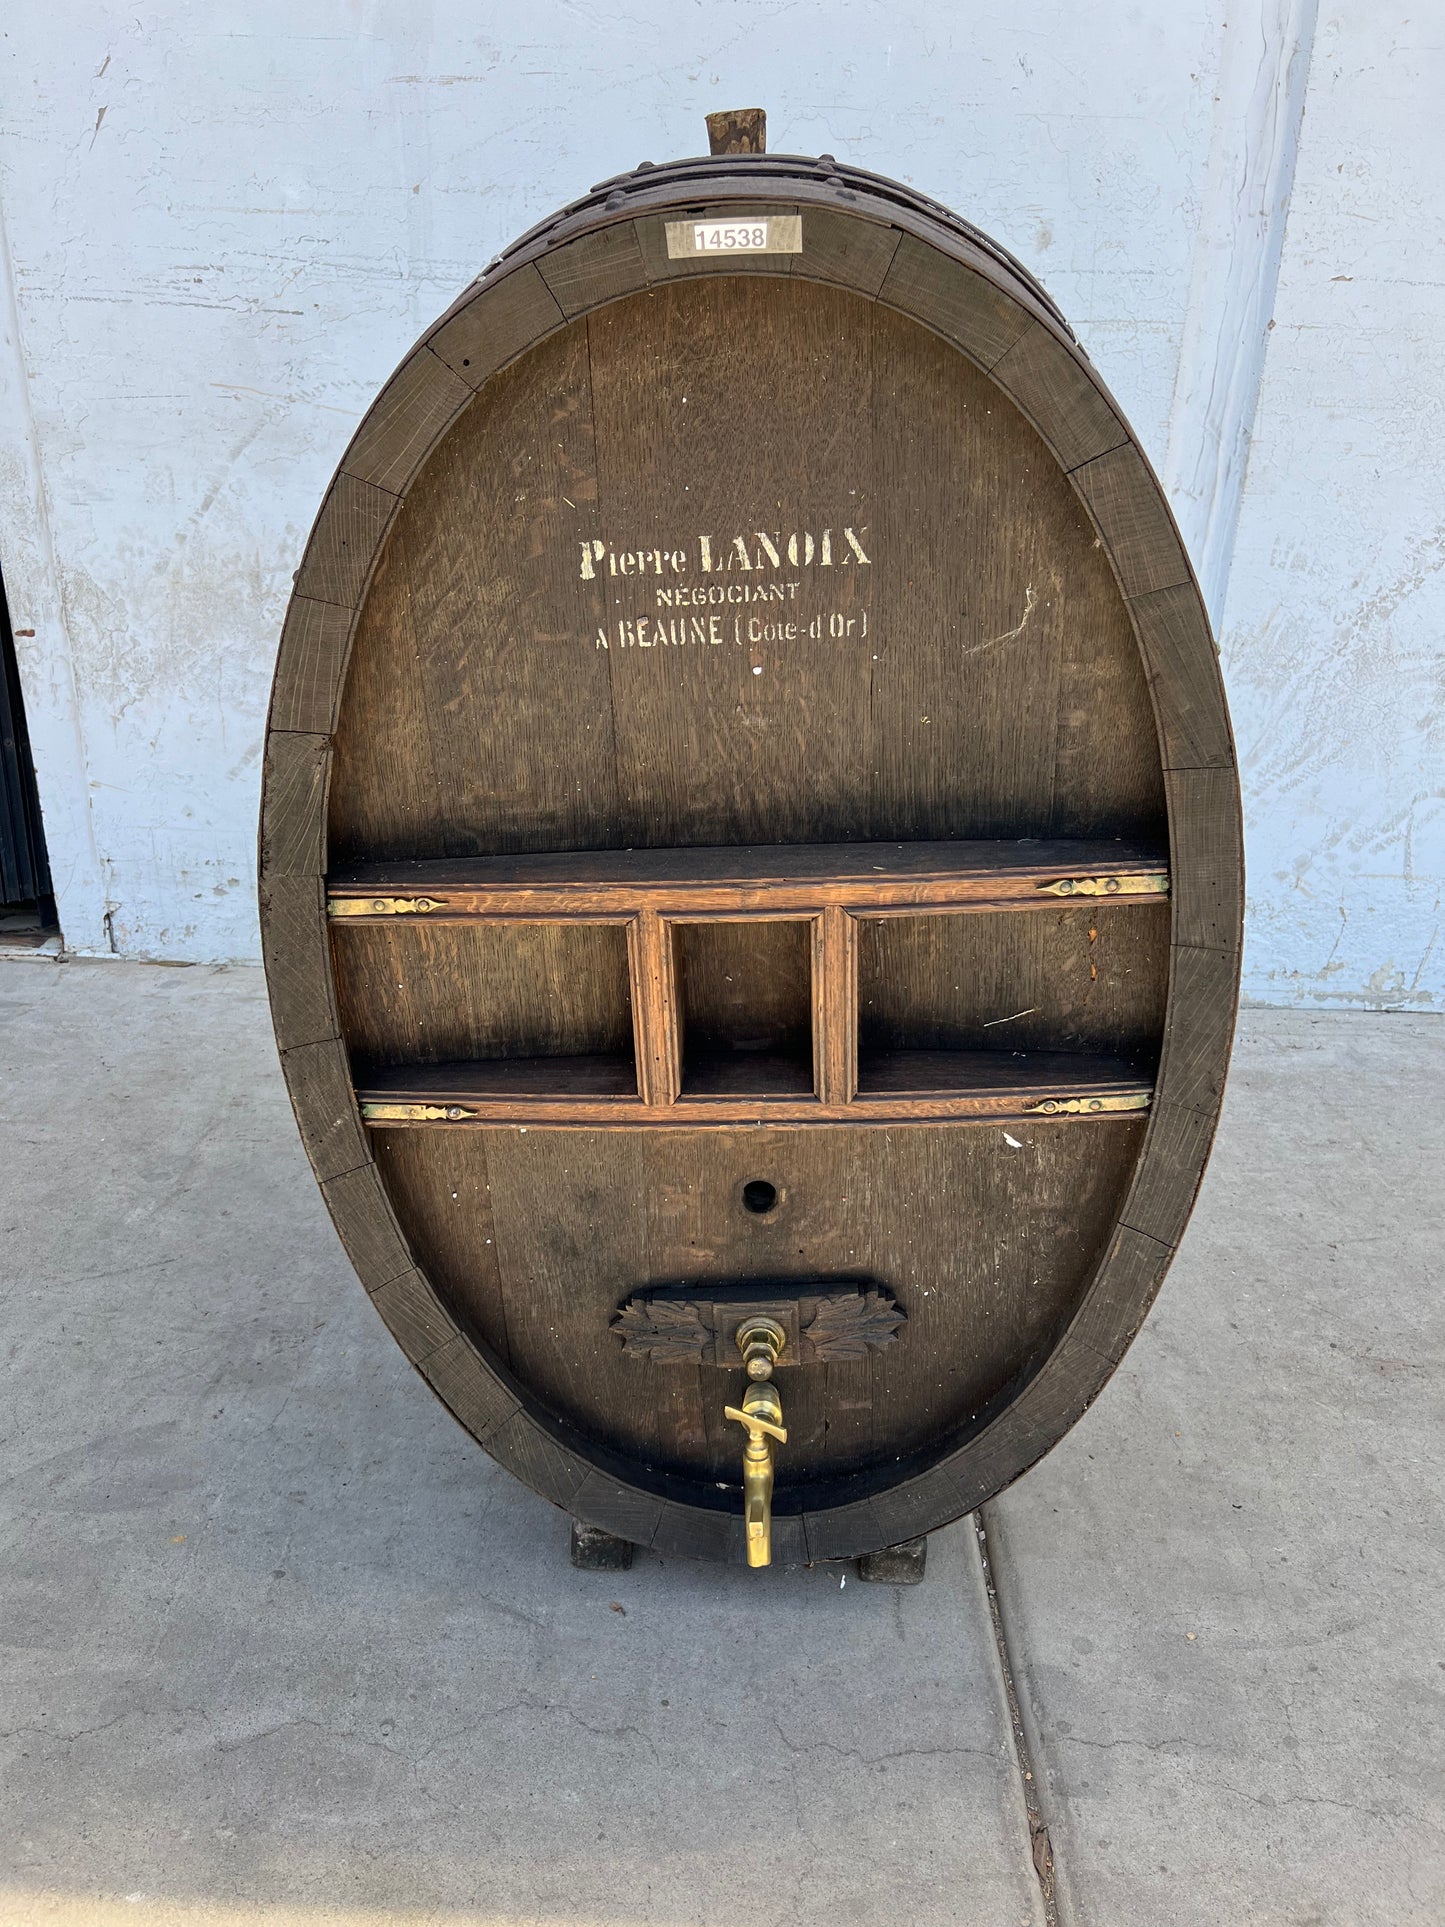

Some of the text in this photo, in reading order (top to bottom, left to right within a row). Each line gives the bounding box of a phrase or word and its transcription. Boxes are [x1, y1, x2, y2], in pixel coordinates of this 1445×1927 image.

[696, 228, 765, 250] 14538
[579, 527, 871, 580] Pierre LANOIX
[618, 616, 723, 648] BEAUNE
